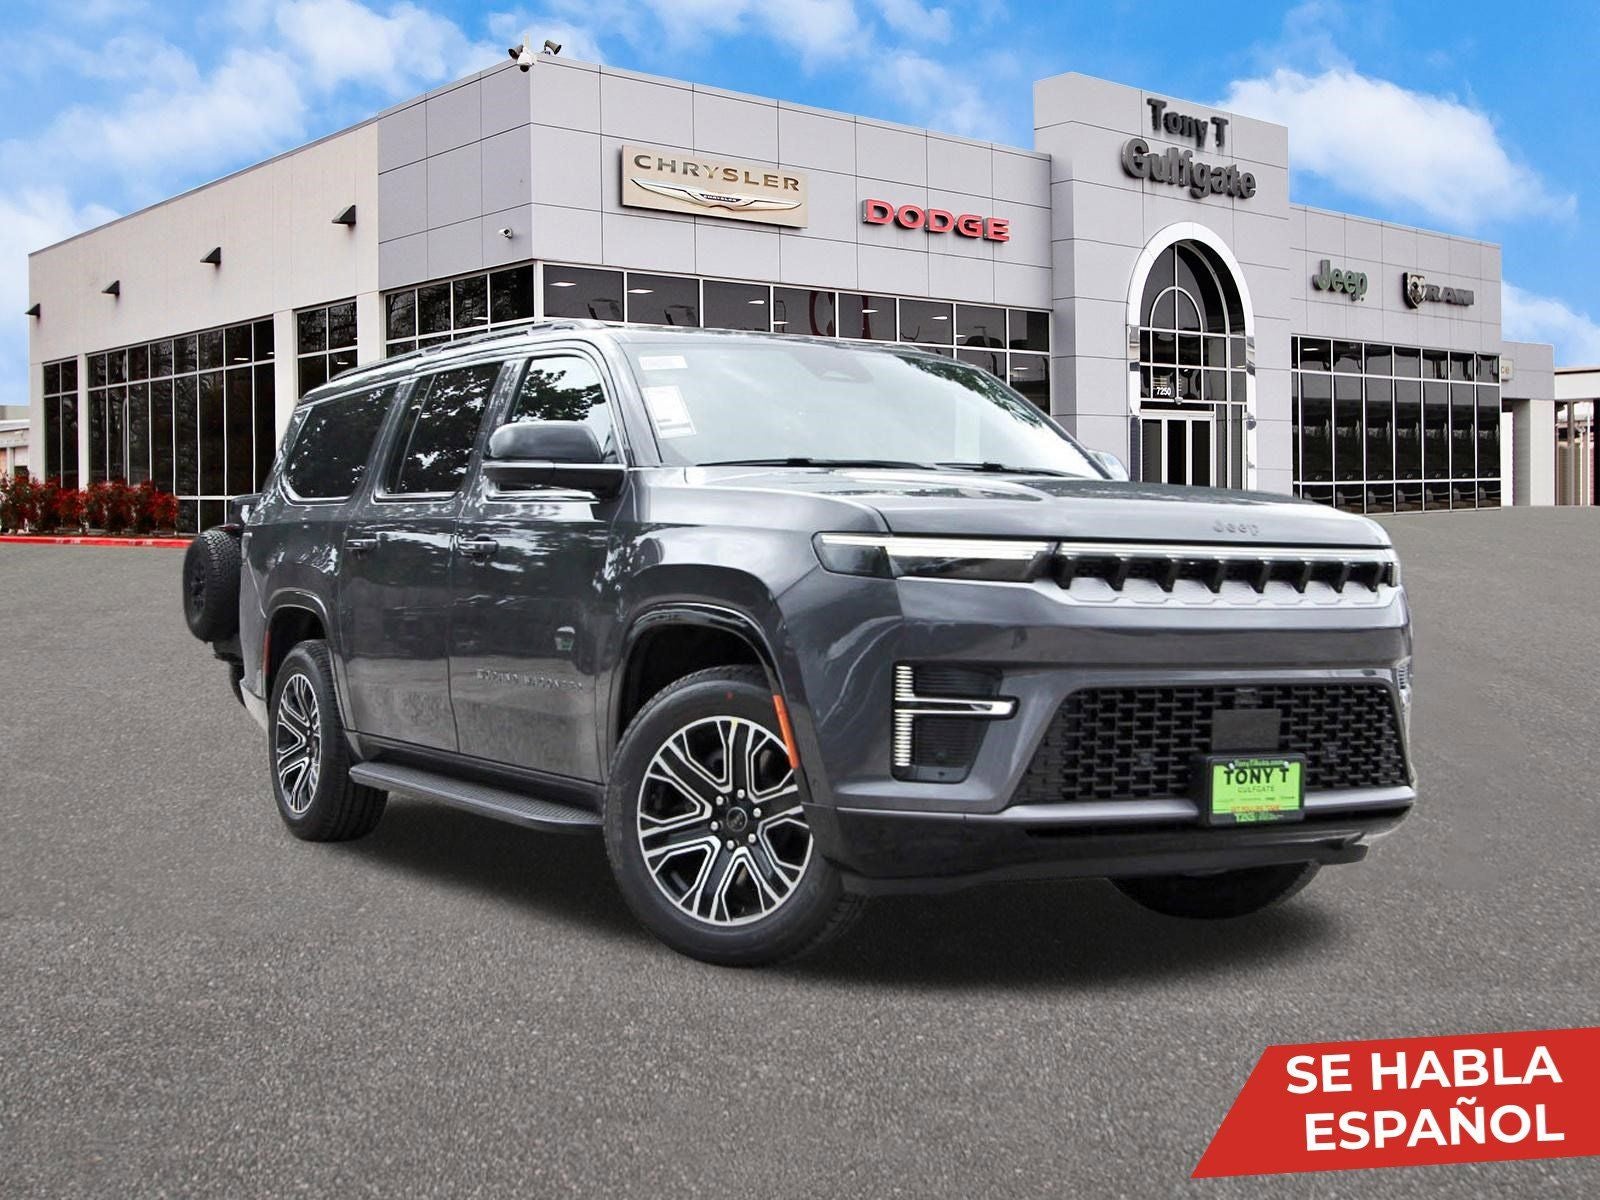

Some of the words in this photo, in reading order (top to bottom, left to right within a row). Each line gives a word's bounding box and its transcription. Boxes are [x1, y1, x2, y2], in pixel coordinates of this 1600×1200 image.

[1147, 98, 1208, 148] Tony
[1210, 116, 1229, 148] T
[633, 153, 800, 192] CHRYSLER
[1121, 137, 1257, 199] Gulfgate
[862, 198, 1011, 242] DODGE
[1312, 259, 1368, 302] Jeep
[1424, 284, 1475, 306] RAM
[1156, 386, 1172, 396] 7250
[1212, 519, 1260, 537] Jeep
[1224, 768, 1274, 785] TONY
[1279, 767, 1290, 783] T
